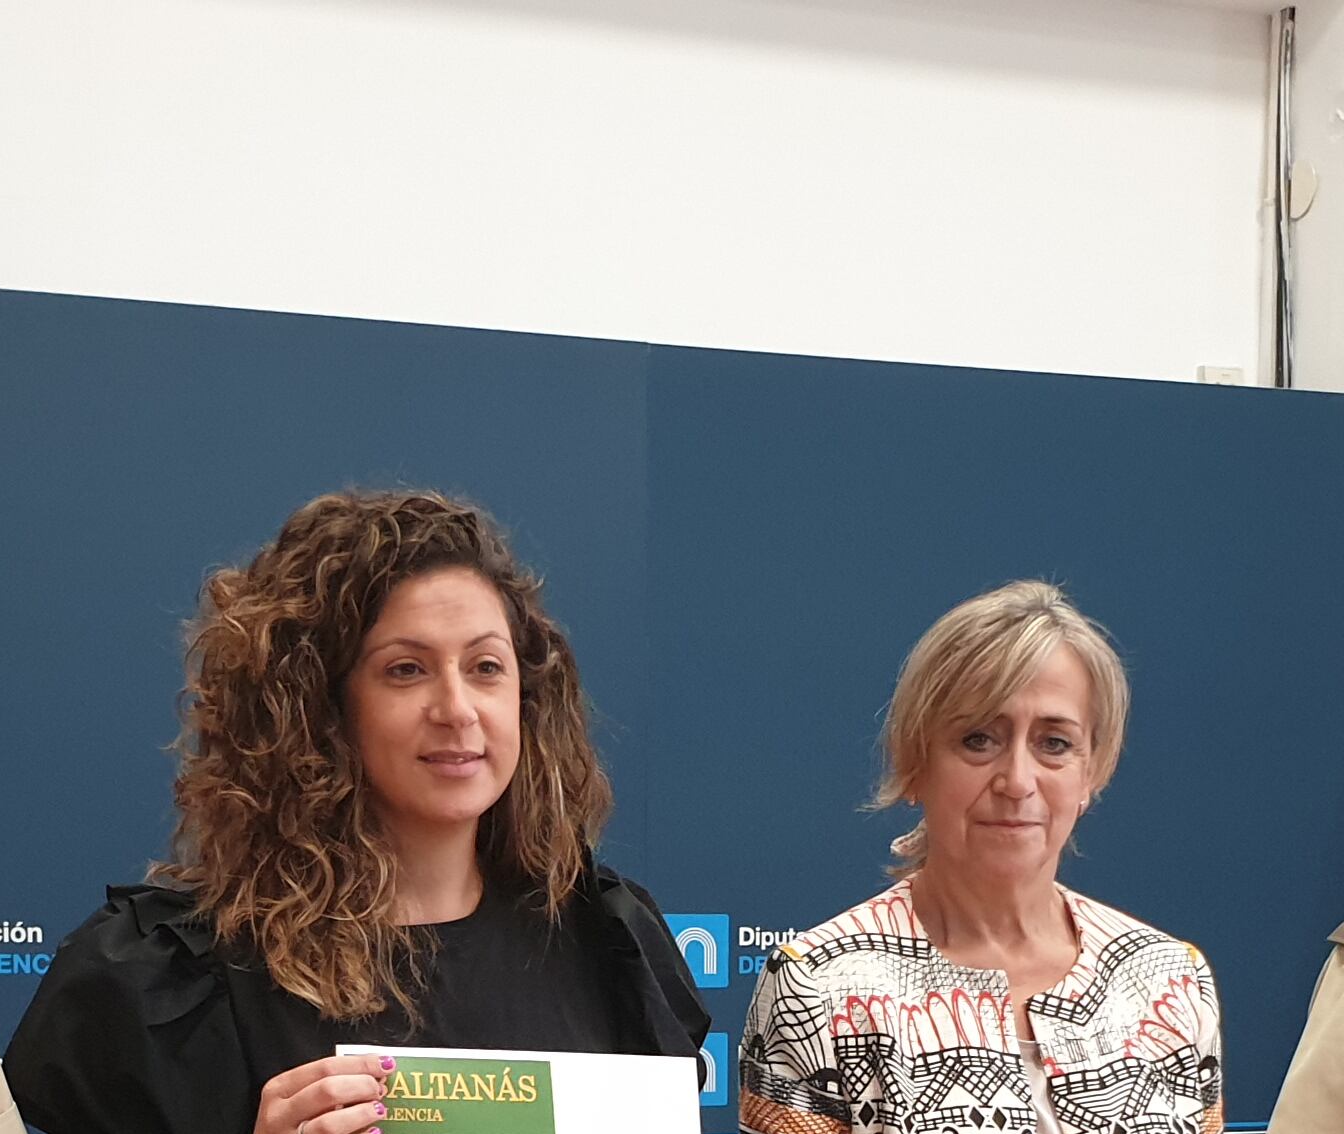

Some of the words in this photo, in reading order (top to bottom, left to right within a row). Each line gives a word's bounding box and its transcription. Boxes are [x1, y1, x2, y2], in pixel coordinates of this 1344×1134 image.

[738, 926, 799, 951] Diput
[386, 1067, 537, 1102] ALTANÁS
[383, 1107, 444, 1122] LENCIA
